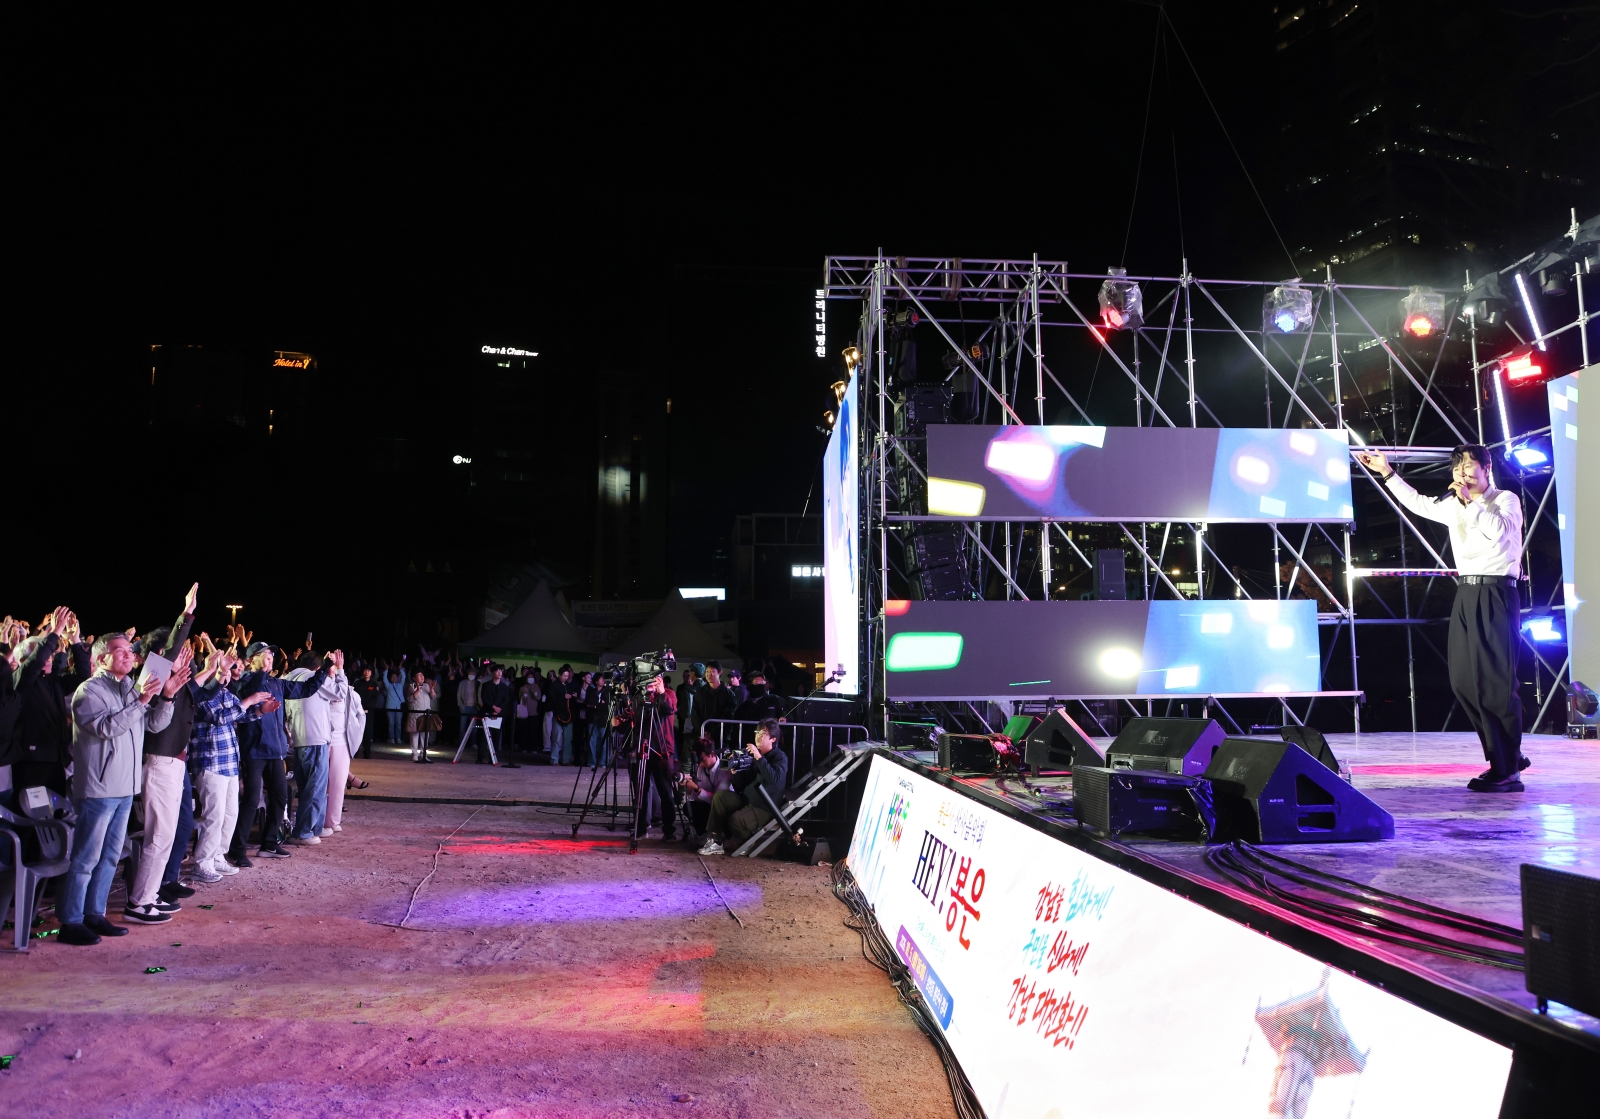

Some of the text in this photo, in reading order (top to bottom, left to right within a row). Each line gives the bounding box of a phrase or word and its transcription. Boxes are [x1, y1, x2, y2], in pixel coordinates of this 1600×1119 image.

[272, 358, 295, 367] Hotel
[481, 345, 500, 354] Chan
[506, 347, 525, 356] Chan
[953, 807, 987, 849] 산사음악회
[912, 830, 957, 914] HEY!
[946, 856, 985, 950] 봉은
[1035, 881, 1065, 923] 강남을
[1047, 930, 1090, 977] 신나게!
[1006, 974, 1089, 1050] 강남 대전환!!
